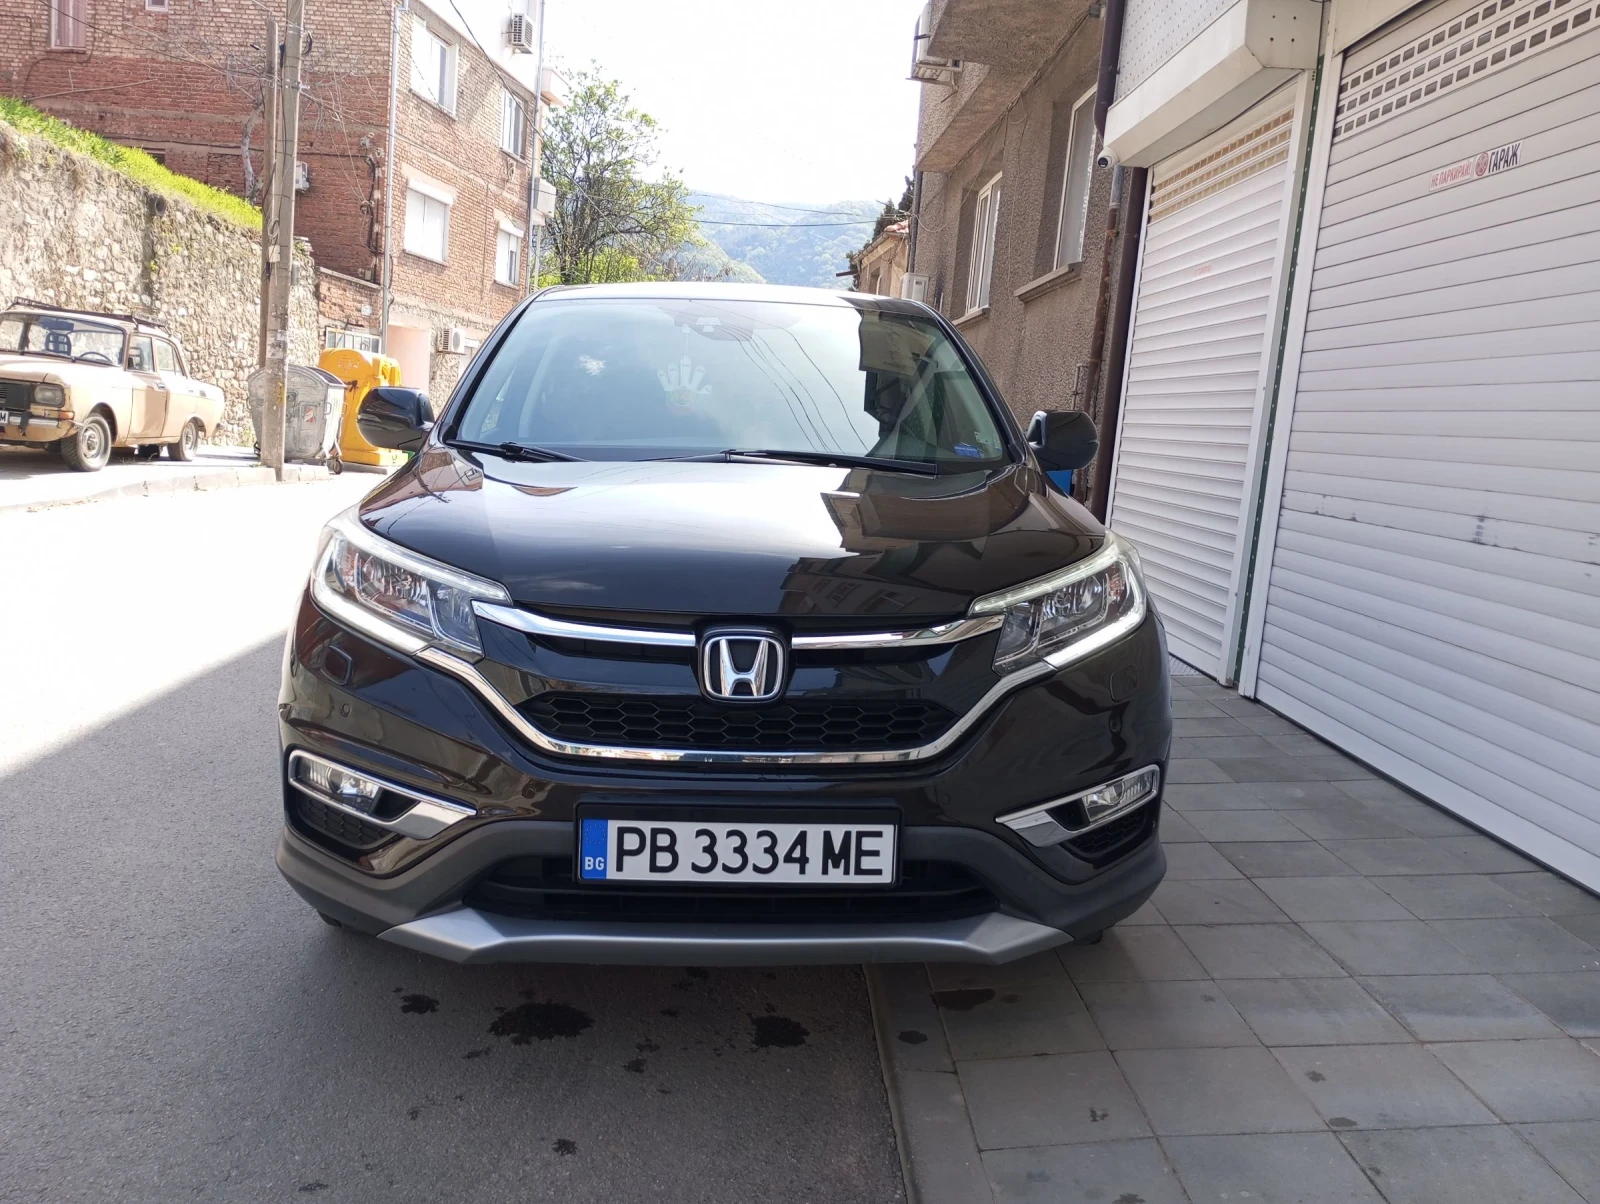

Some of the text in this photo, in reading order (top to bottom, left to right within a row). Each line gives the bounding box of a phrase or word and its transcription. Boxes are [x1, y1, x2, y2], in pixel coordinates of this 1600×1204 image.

[1488, 142, 1520, 173] ГАРАЖ
[1431, 173, 1440, 188] НЕ
[615, 826, 883, 876] PB 3334 ME
[585, 856, 605, 870] BG
